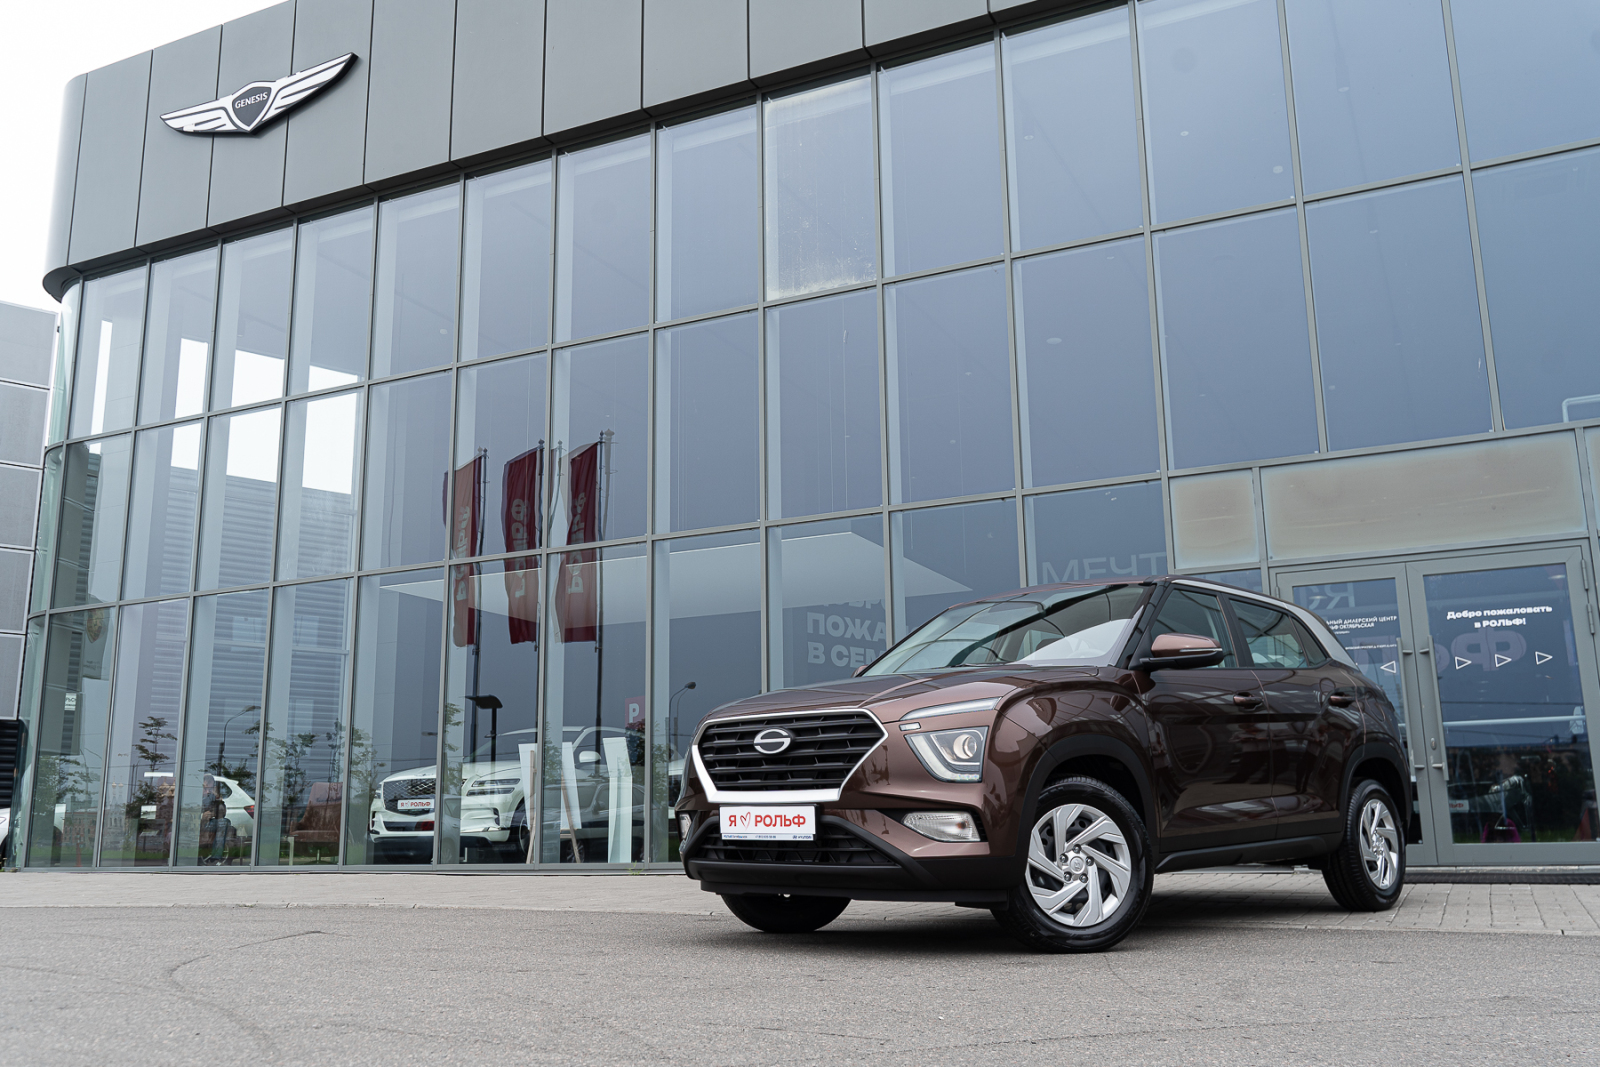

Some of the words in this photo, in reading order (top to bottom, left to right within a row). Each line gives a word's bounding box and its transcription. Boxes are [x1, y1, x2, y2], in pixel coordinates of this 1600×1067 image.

[234, 91, 268, 109] GENESIS
[1343, 616, 1378, 625] ДИЛЕРСКИЙ
[1378, 615, 1398, 623] ЦЕНТР
[1446, 609, 1482, 620] Добро
[1483, 605, 1553, 616] пожаловать
[1482, 617, 1526, 628] РОЛЬФ!
[807, 641, 826, 664] В
[728, 814, 737, 827] Я
[754, 813, 806, 828] РОЛЬФ
